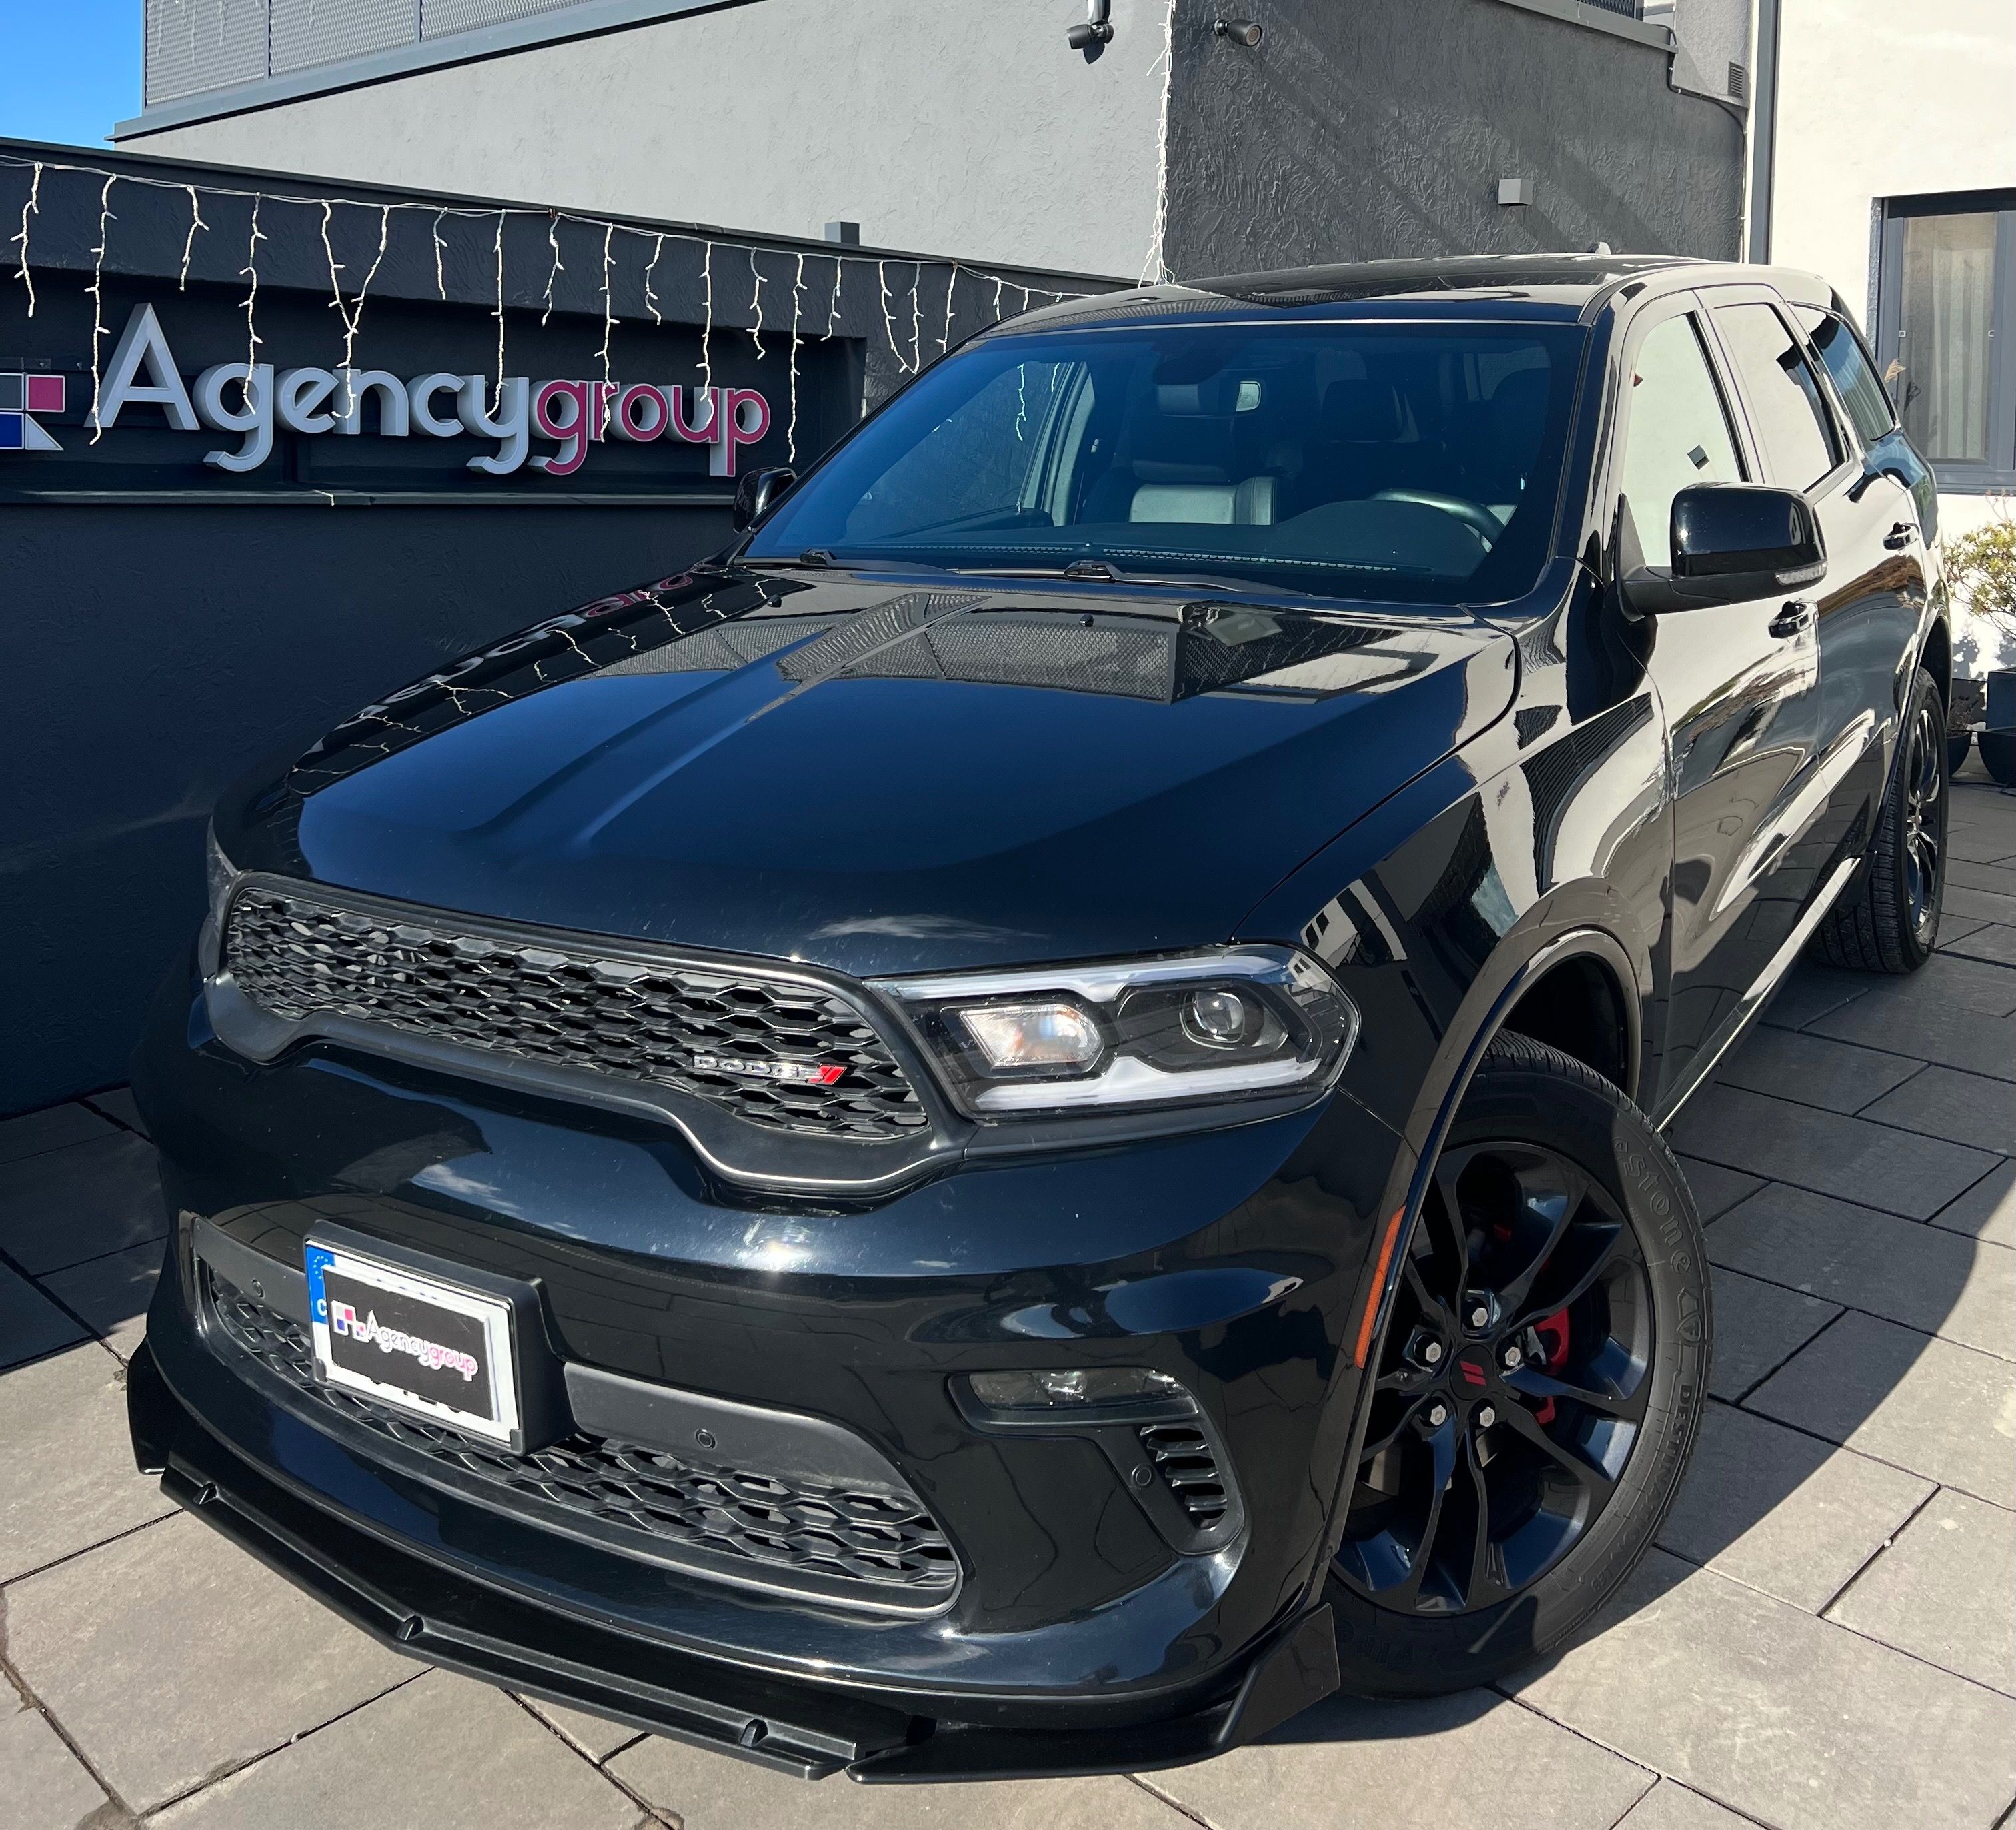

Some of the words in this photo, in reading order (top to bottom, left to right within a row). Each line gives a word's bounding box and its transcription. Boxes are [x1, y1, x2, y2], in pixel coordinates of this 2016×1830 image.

[84, 303, 770, 477] Agencygroup
[694, 1055, 823, 1081] DODGE
[366, 1310, 478, 1382] Agencygroup
